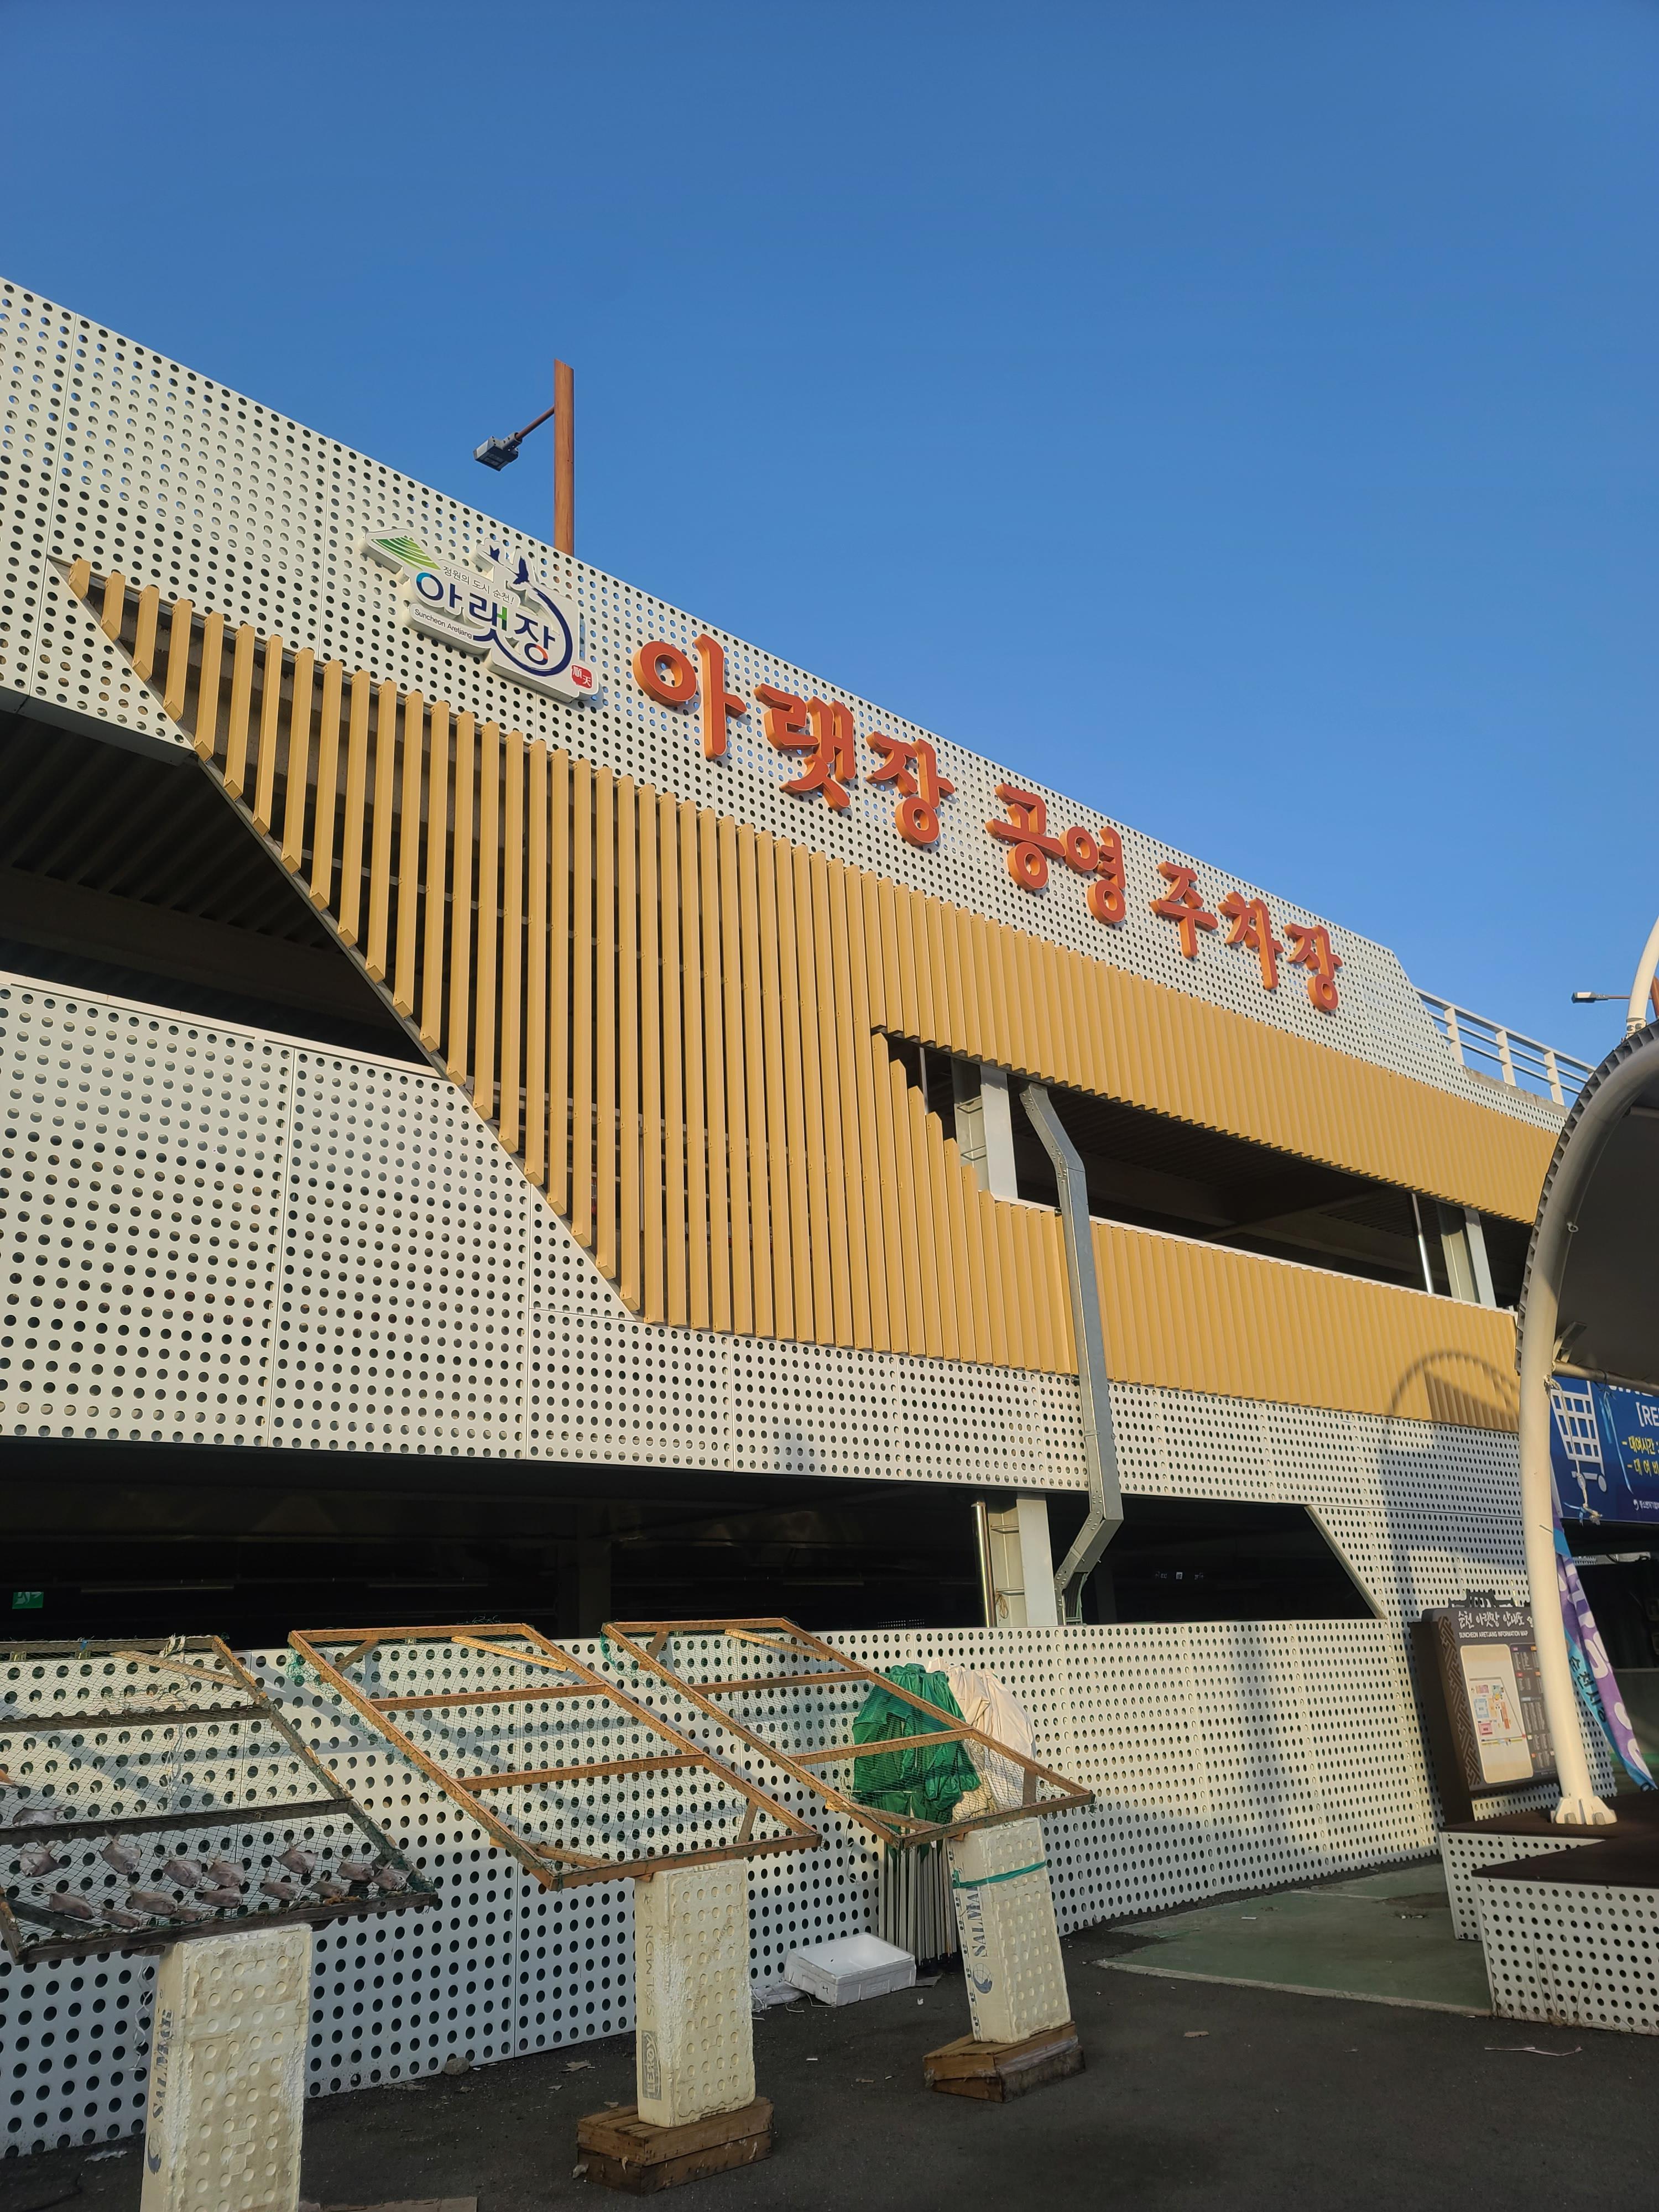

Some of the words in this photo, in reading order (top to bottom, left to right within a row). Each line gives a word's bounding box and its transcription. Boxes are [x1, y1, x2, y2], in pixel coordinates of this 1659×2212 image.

[443, 565, 469, 586] 정원의
[472, 579, 490, 594] 도시
[492, 588, 514, 605] 순천!
[414, 608, 446, 628] Suncheon
[447, 623, 473, 640] Aretjang
[633, 633, 955, 847] 아랫장
[985, 782, 1126, 925] 공영
[1150, 861, 1343, 1013] 주차장
[1636, 1401, 1659, 1427] [RE
[1458, 1610, 1474, 1629] 순천
[1476, 1610, 1500, 1627] 아랫장
[1503, 1610, 1525, 1627] 안내도
